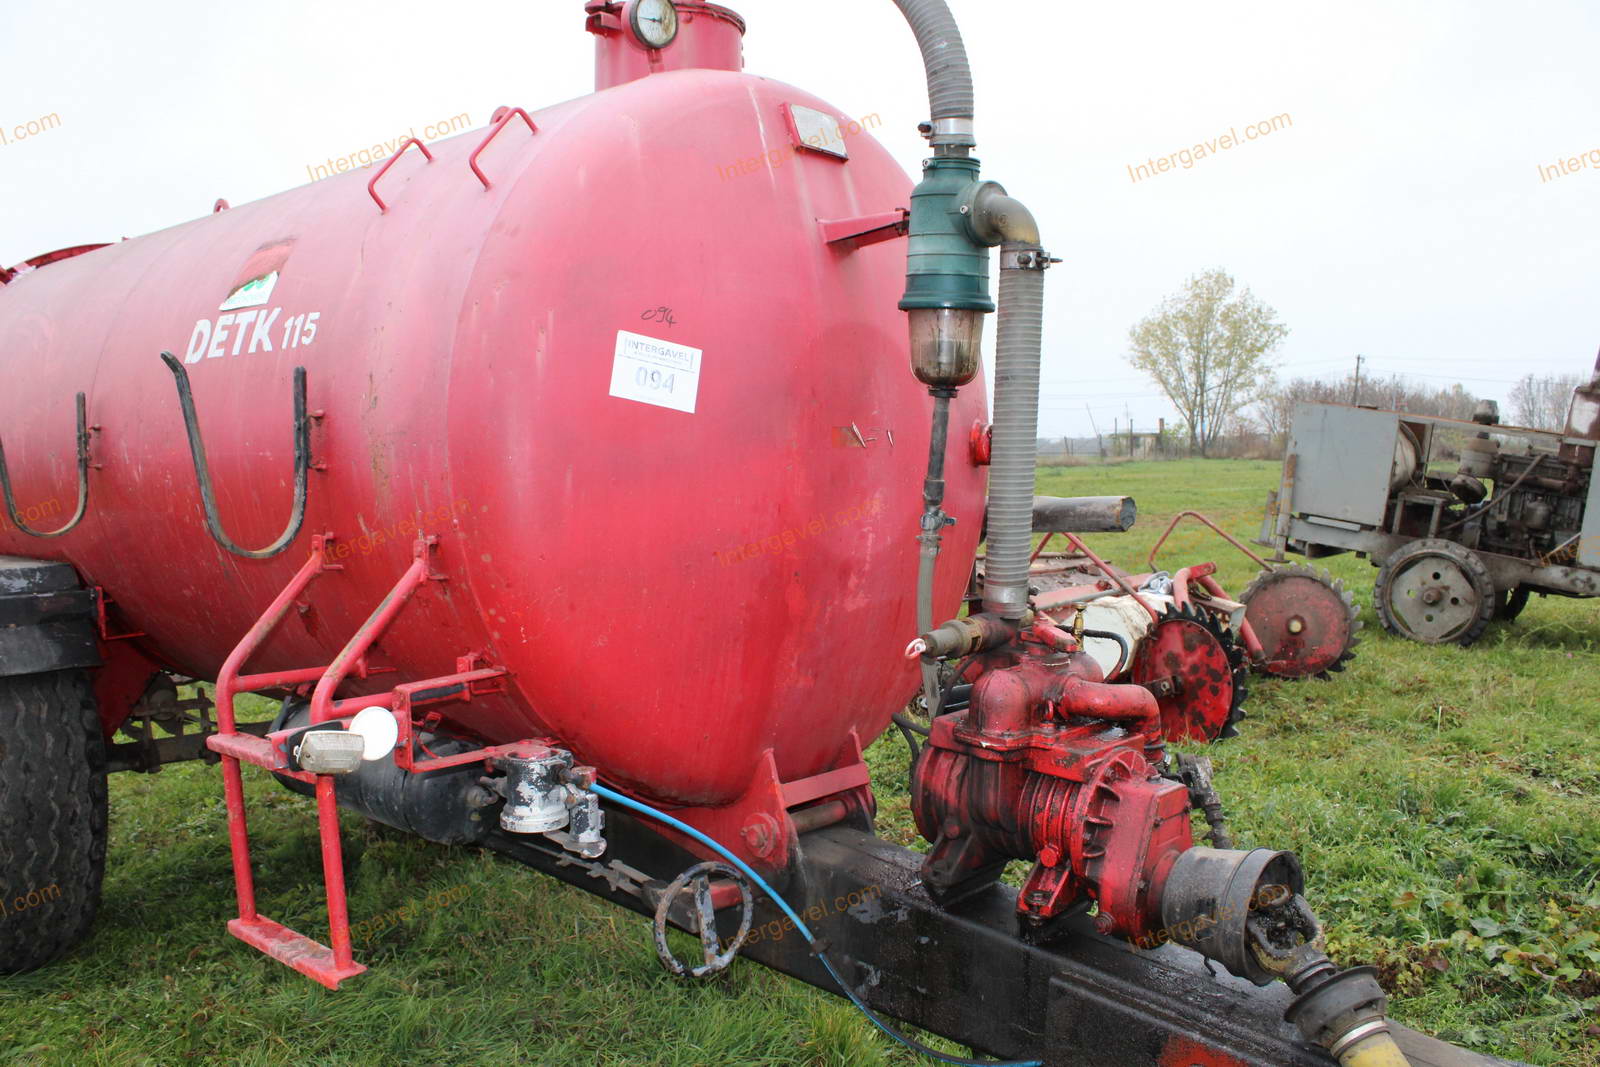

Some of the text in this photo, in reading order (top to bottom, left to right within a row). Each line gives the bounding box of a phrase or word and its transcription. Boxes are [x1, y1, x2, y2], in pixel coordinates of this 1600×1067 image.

[641, 306, 677, 328] 094
[184, 307, 321, 364] DETK 115
[627, 339, 690, 362] INTERGAVEL
[635, 366, 675, 394] 094
